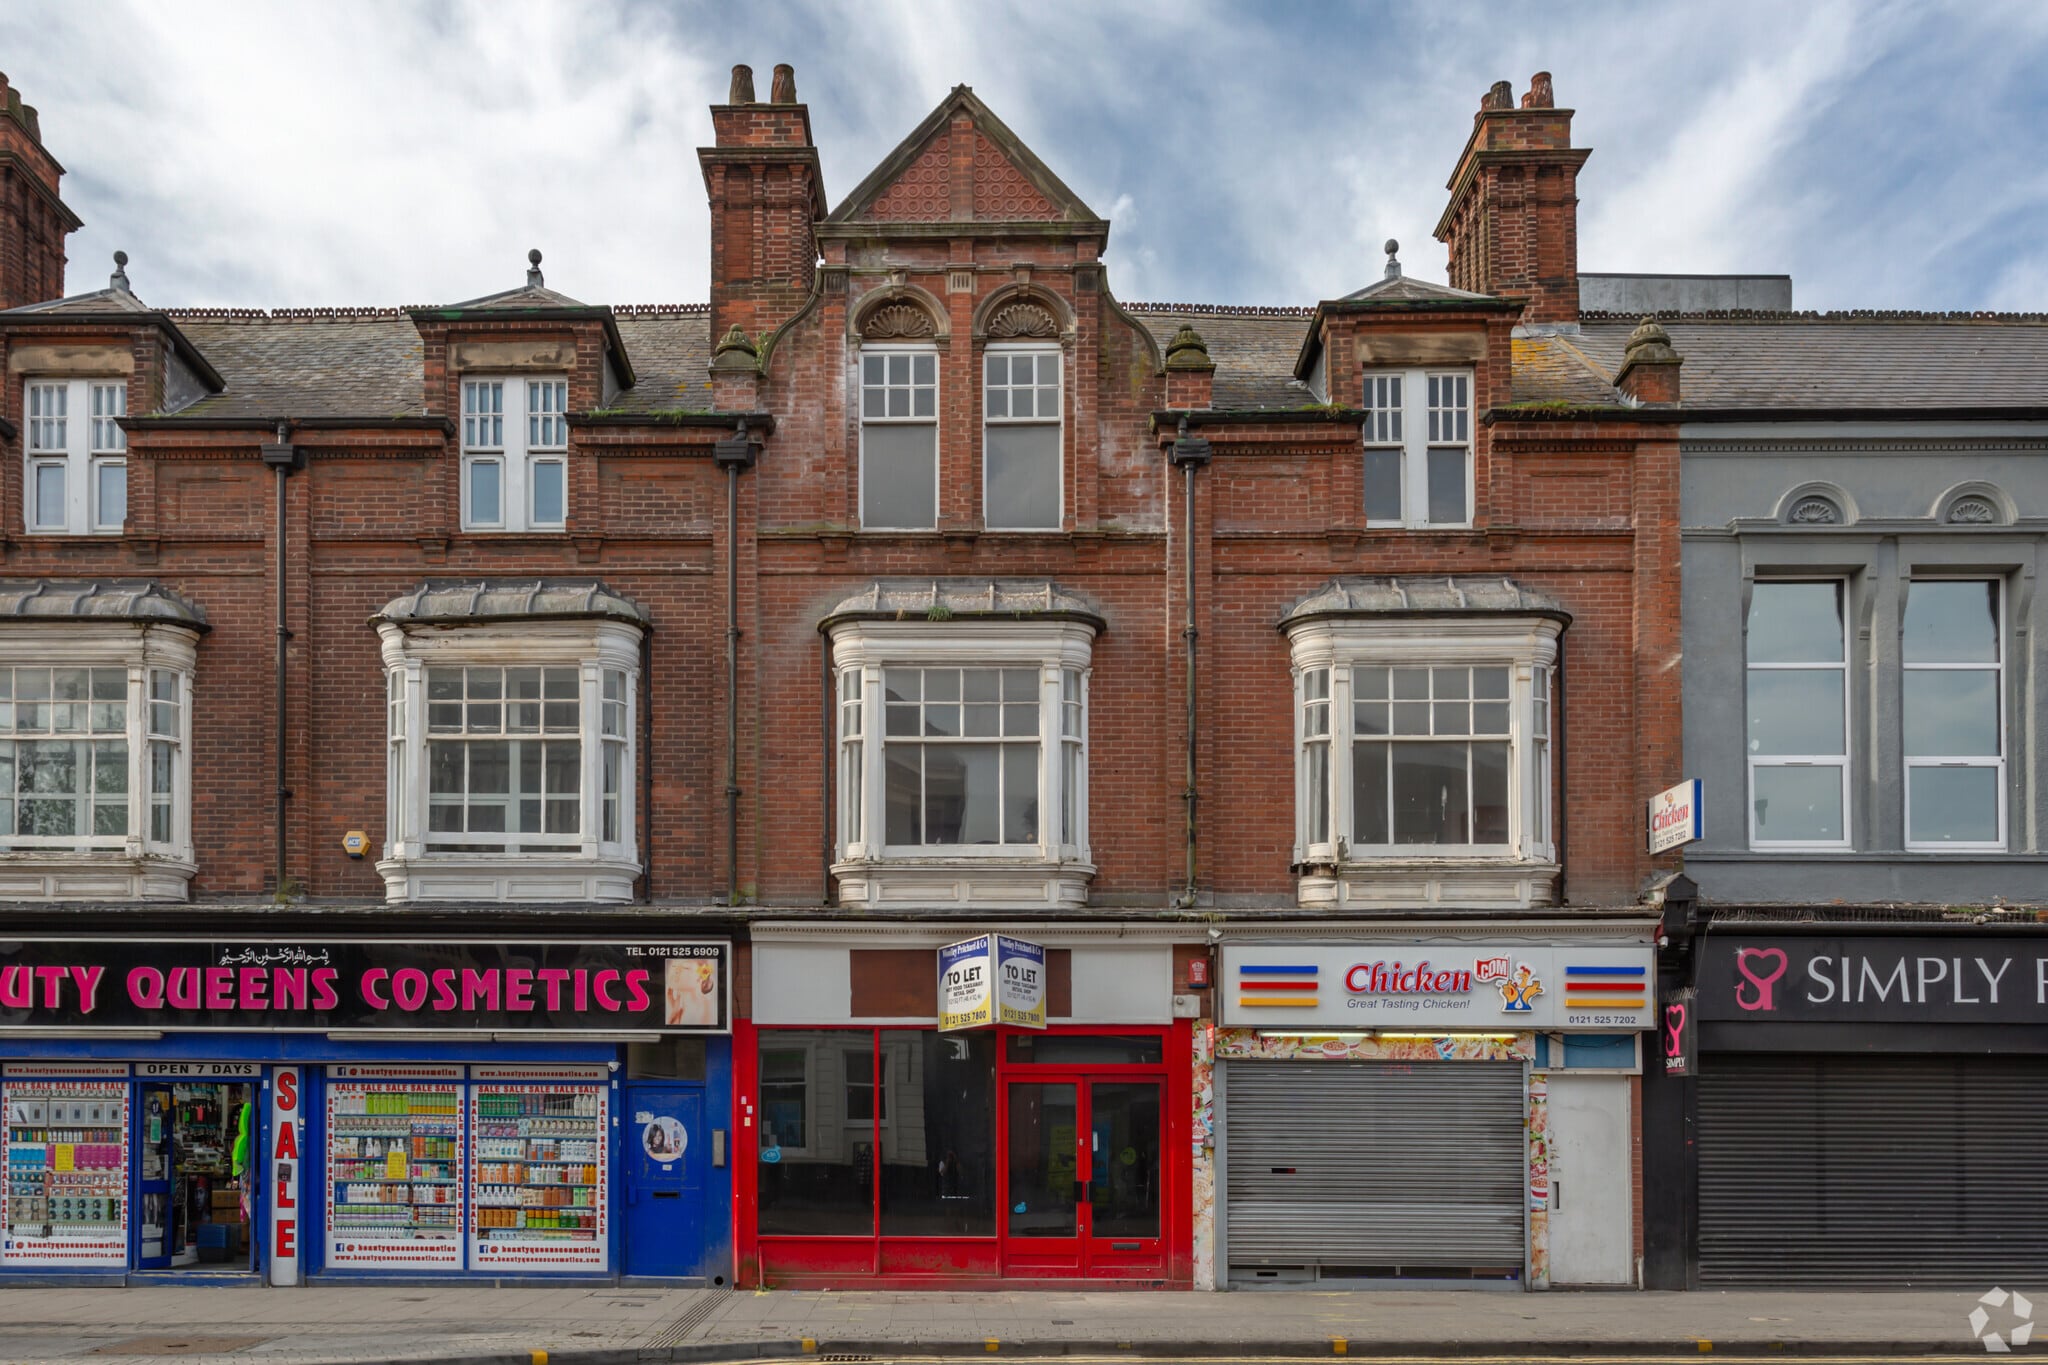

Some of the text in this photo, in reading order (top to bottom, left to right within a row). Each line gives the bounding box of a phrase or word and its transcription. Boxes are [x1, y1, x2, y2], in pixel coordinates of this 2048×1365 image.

[1652, 804, 1689, 831] Chicken
[626, 947, 720, 957] TEL. 0121 525 6909
[947, 966, 981, 986] TO LET
[1005, 964, 1037, 983] TO LET
[1344, 960, 1473, 993] Chicken
[1807, 956, 2013, 1003] SIMPLY
[126, 966, 339, 1010] QUEENS
[361, 968, 650, 1011] COSMETICS
[1347, 999, 1471, 1010] Great Tasting Chicken!
[945, 1015, 959, 1025] 0121
[960, 1013, 971, 1023] 525
[1004, 1009, 1017, 1019] 0121
[1569, 1016, 1637, 1024] 0121 525 7202
[1666, 1056, 1686, 1069] SIMPLY
[147, 1064, 253, 1074] OPEN 7 DAYS
[5, 1082, 125, 1090] SALE SALE SALE SALE SALE
[335, 1084, 457, 1092] SALE SALE SALE SALE SALE
[478, 1085, 600, 1094] SALE SALE SALE SALE SALE
[276, 1072, 298, 1258] SALE
